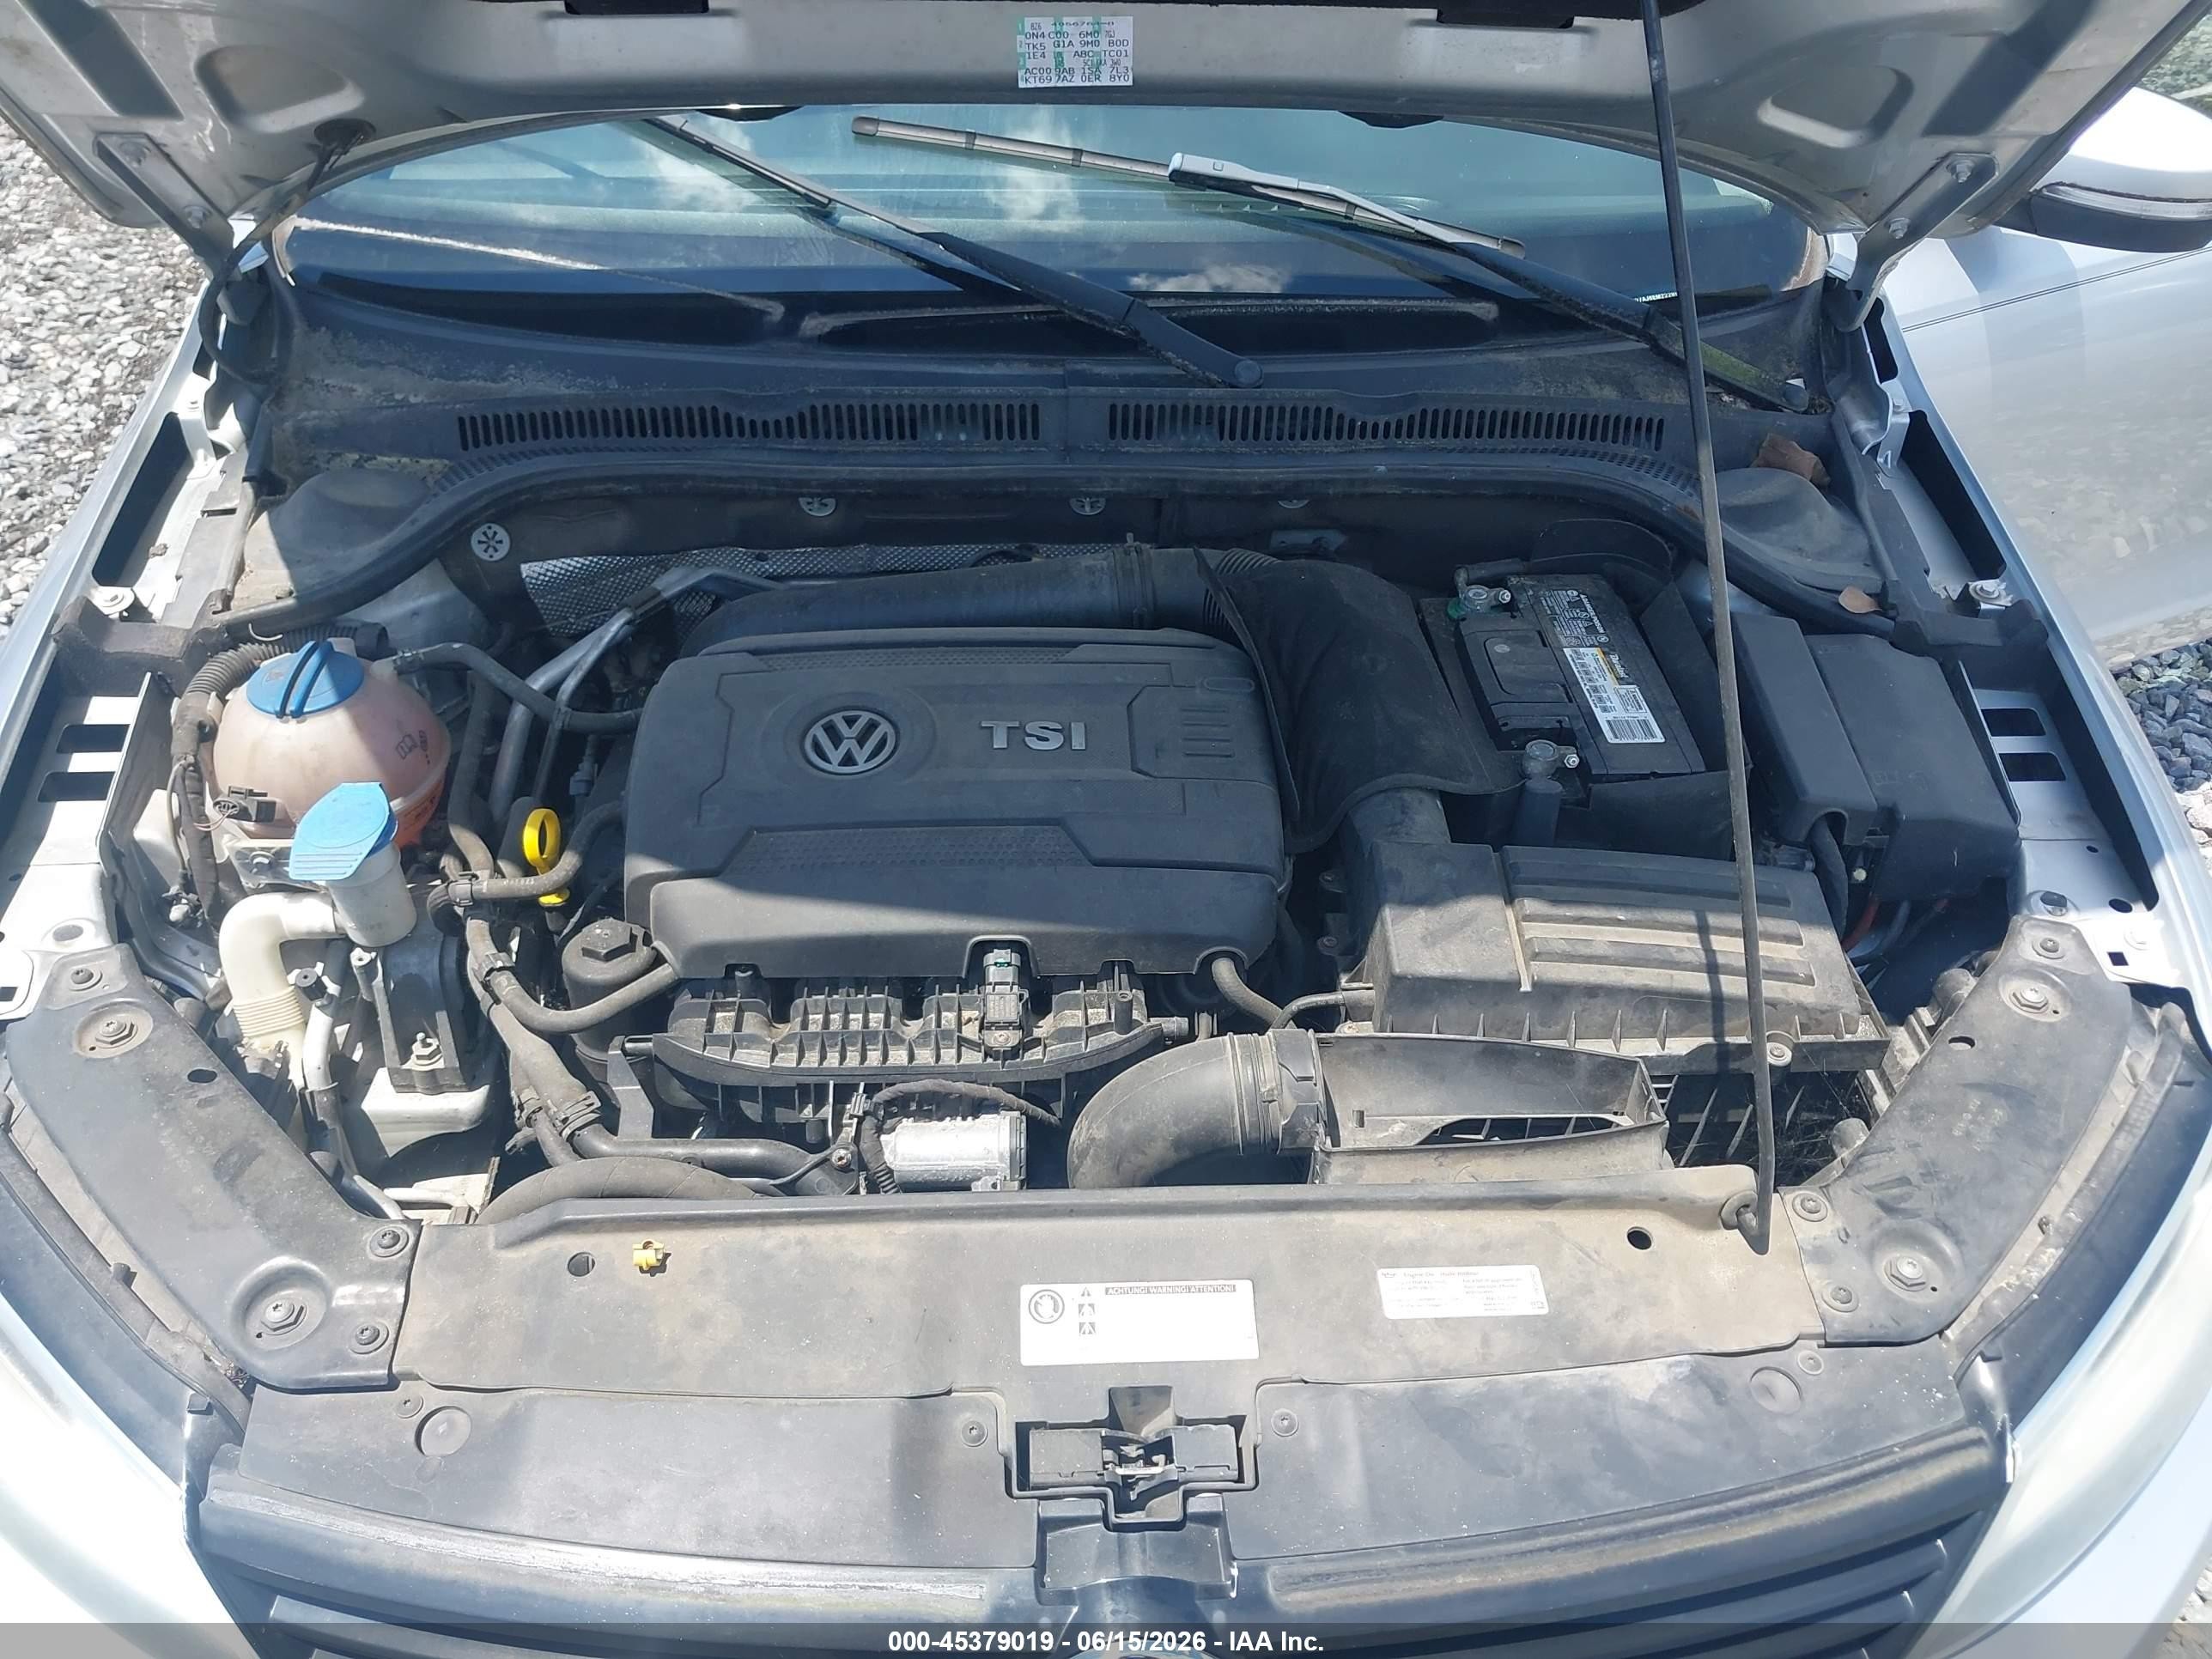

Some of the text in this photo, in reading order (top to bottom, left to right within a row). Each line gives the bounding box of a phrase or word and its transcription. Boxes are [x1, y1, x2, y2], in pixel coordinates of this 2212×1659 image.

[1025, 42, 1046, 51] TK5
[1053, 40, 1074, 48] G1A
[1102, 49, 1129, 58] TC01
[1024, 75, 1053, 84] KT69
[1055, 75, 1075, 83] 7AZ
[980, 720, 1086, 751] TSI
